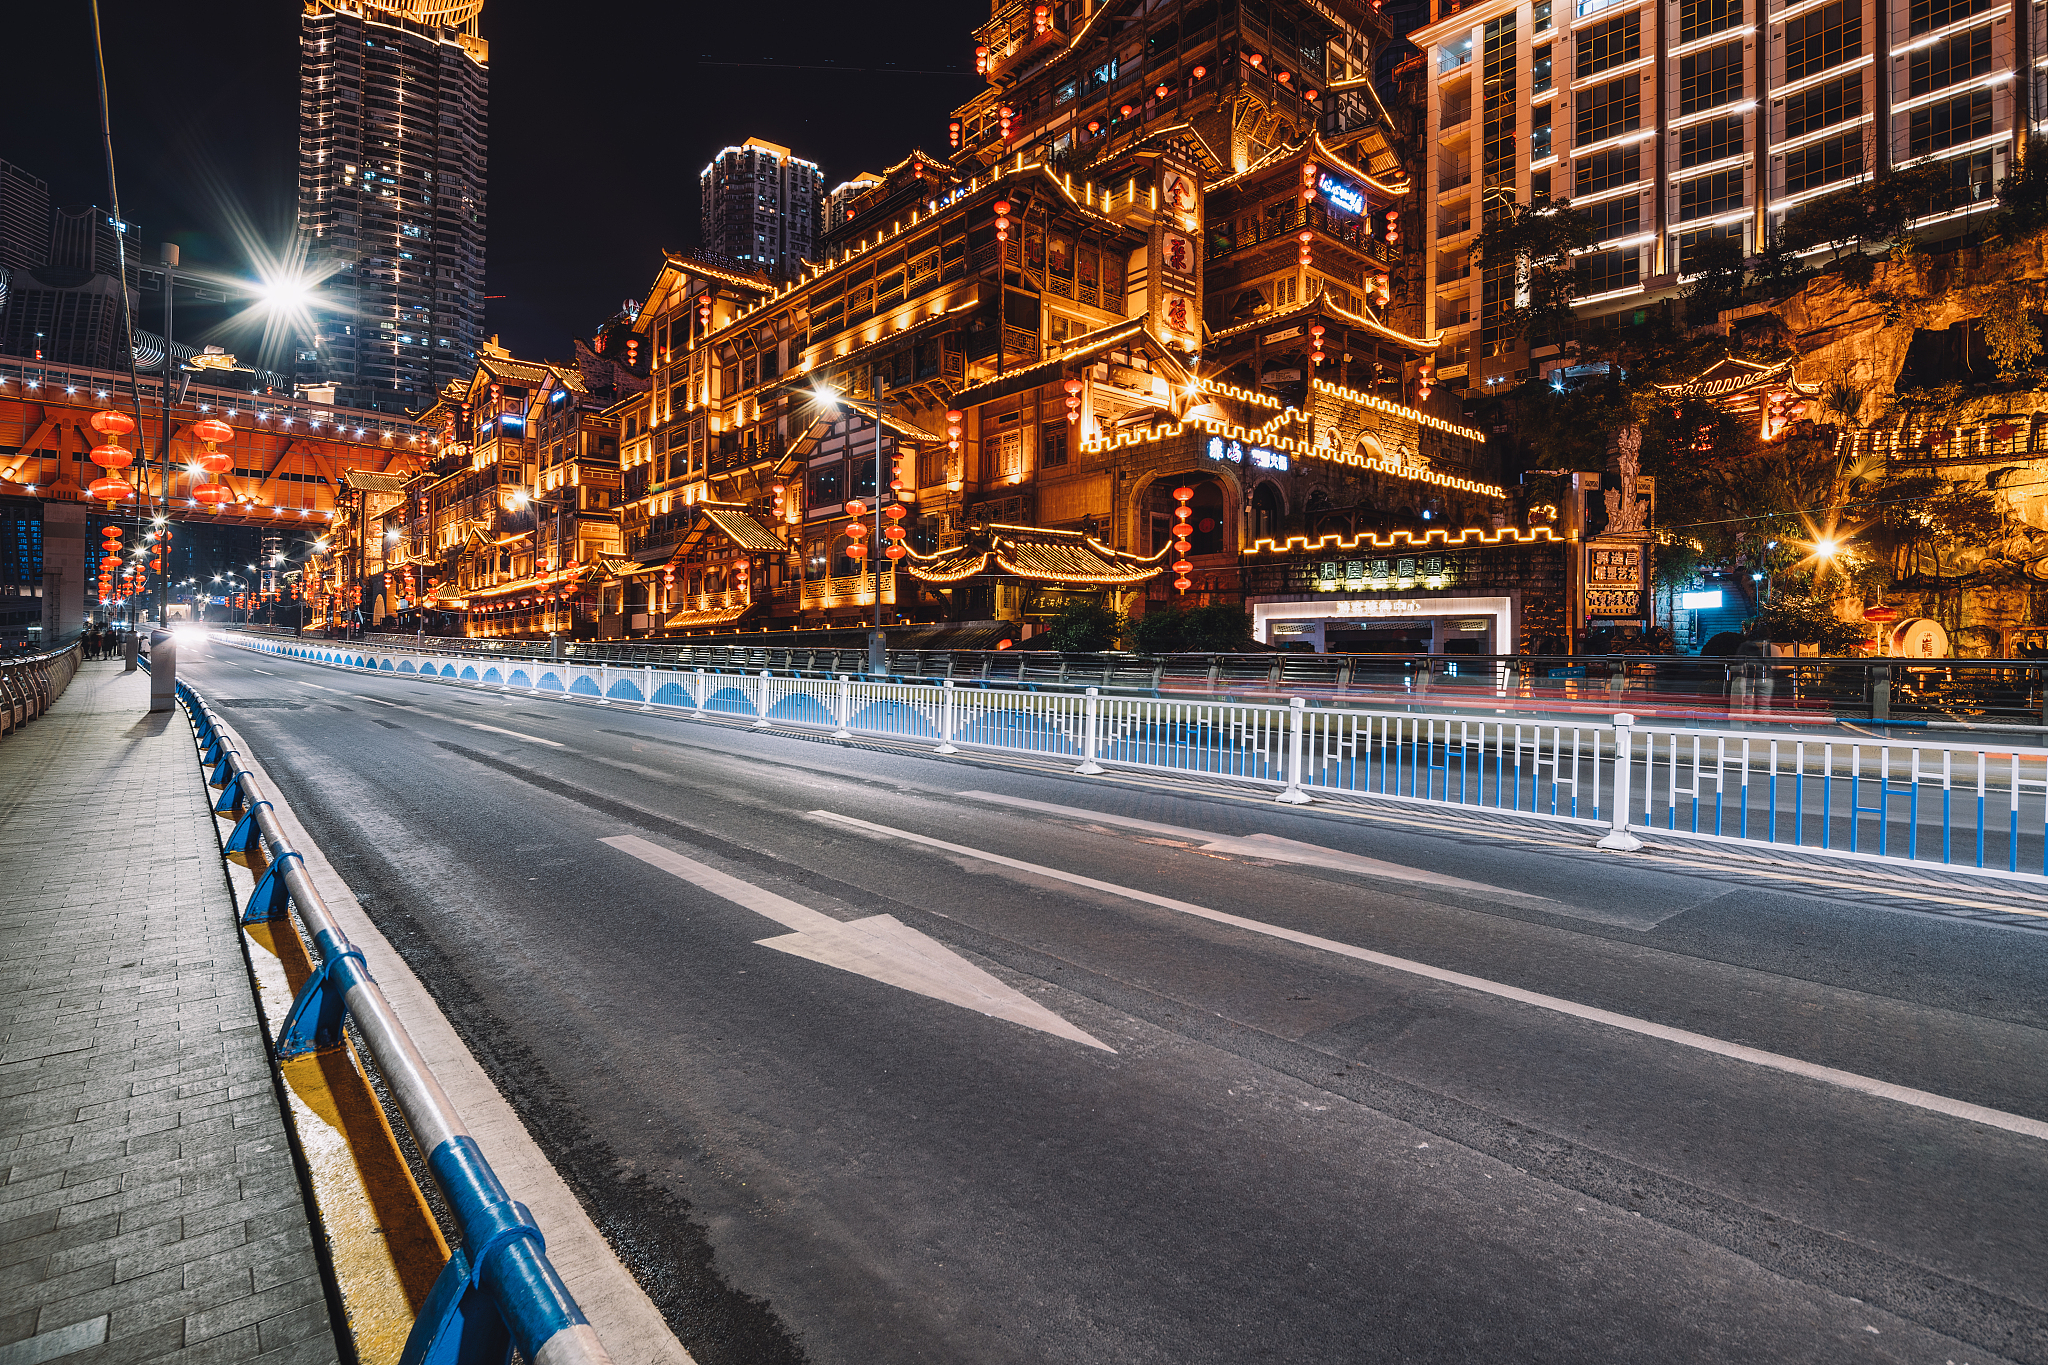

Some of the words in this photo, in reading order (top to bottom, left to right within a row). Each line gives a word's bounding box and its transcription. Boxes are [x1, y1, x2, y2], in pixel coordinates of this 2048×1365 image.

[1336, 600, 1421, 614] 游客接待中心
